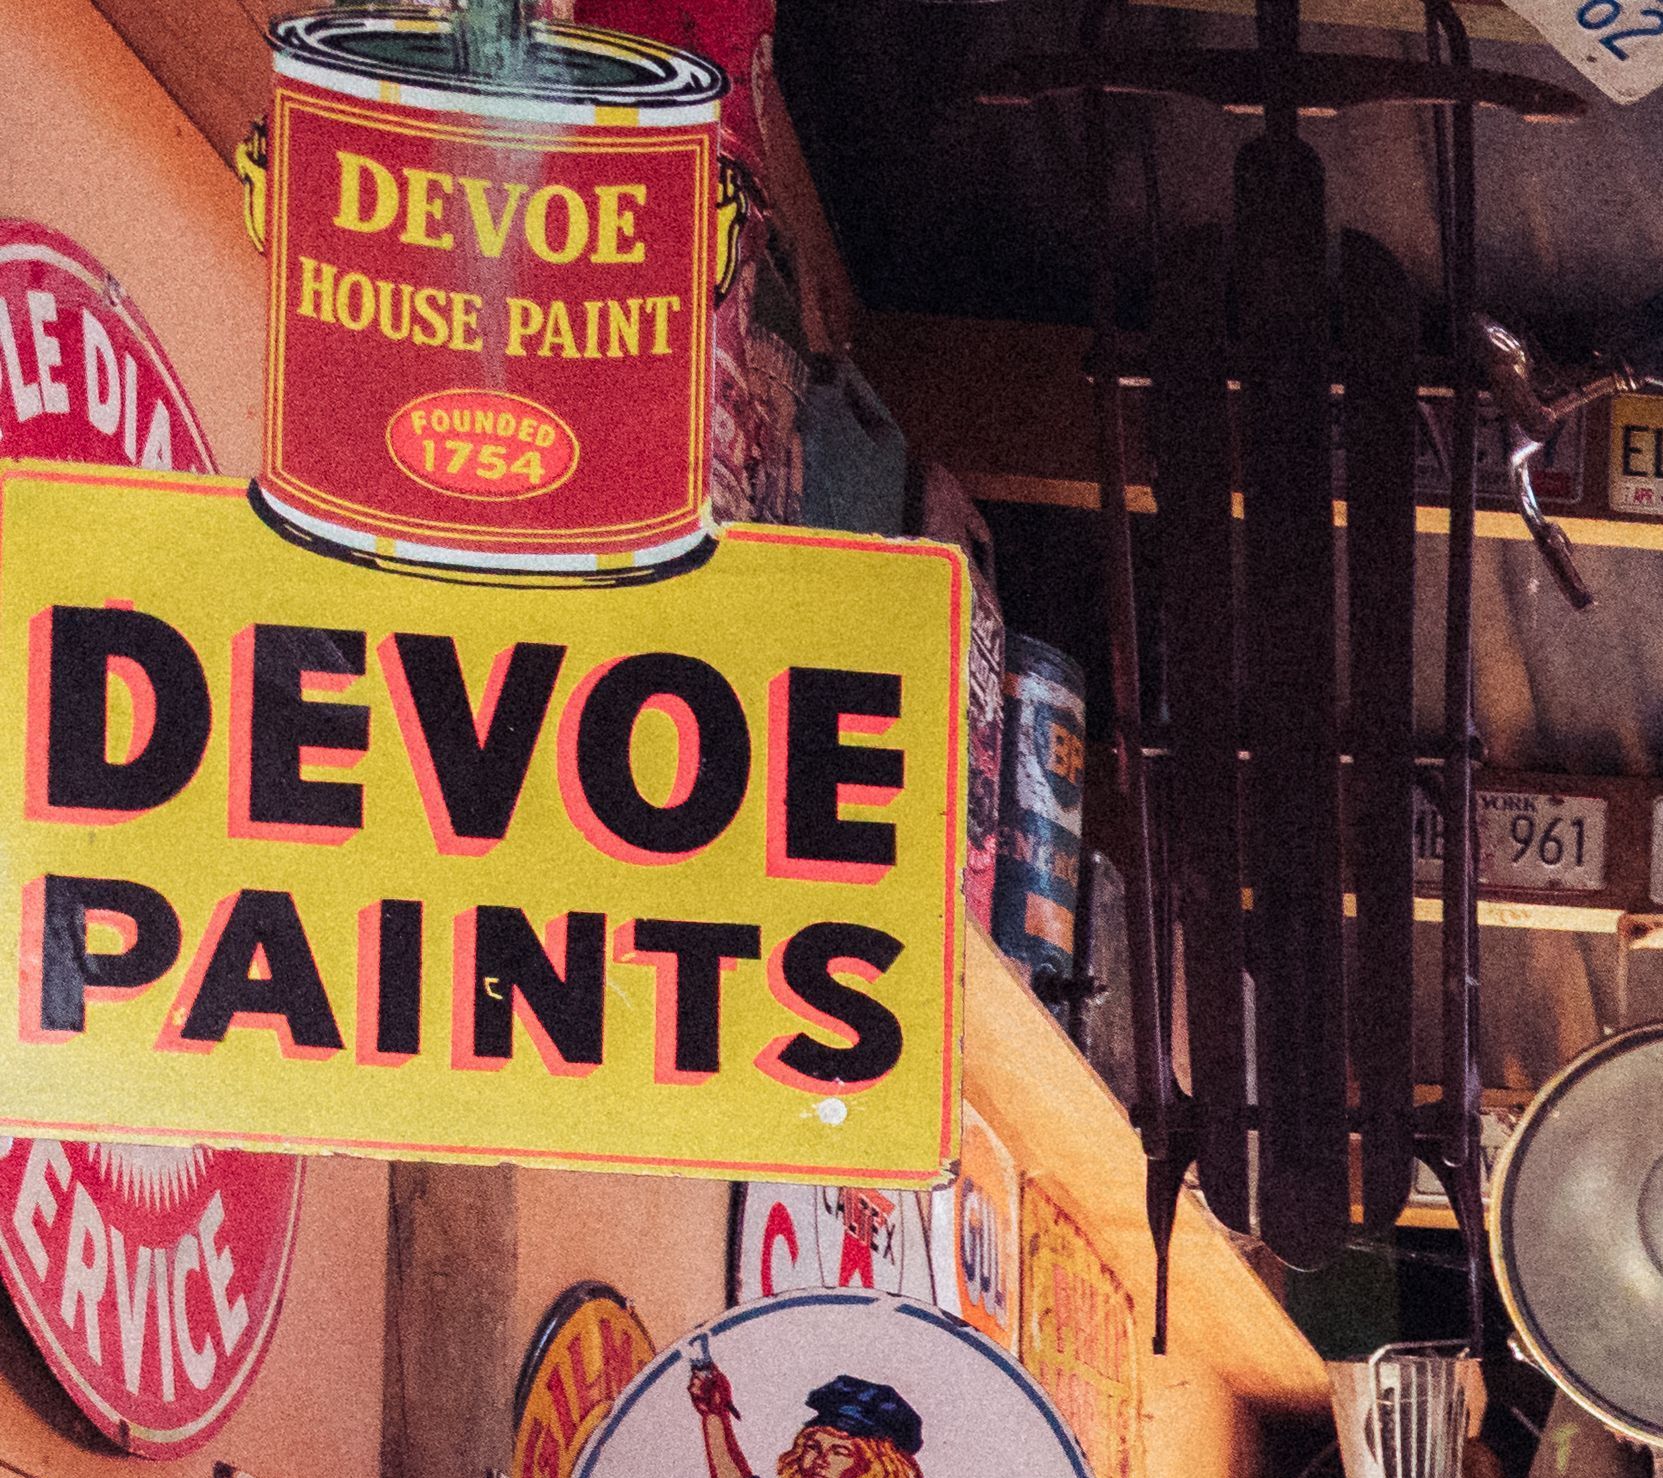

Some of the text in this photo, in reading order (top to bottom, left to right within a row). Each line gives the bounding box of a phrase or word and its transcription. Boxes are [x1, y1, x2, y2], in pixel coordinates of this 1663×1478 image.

[333, 150, 648, 267] DEVOE
[299, 256, 685, 362] HOUSE PAINT
[411, 406, 557, 451] FOUNDED
[421, 438, 547, 487] 1754
[28, 605, 906, 880] DEVOE
[1511, 813, 1585, 868] 961
[22, 873, 905, 1094] PAINTS
[10, 1148, 250, 1404] ERVICE
